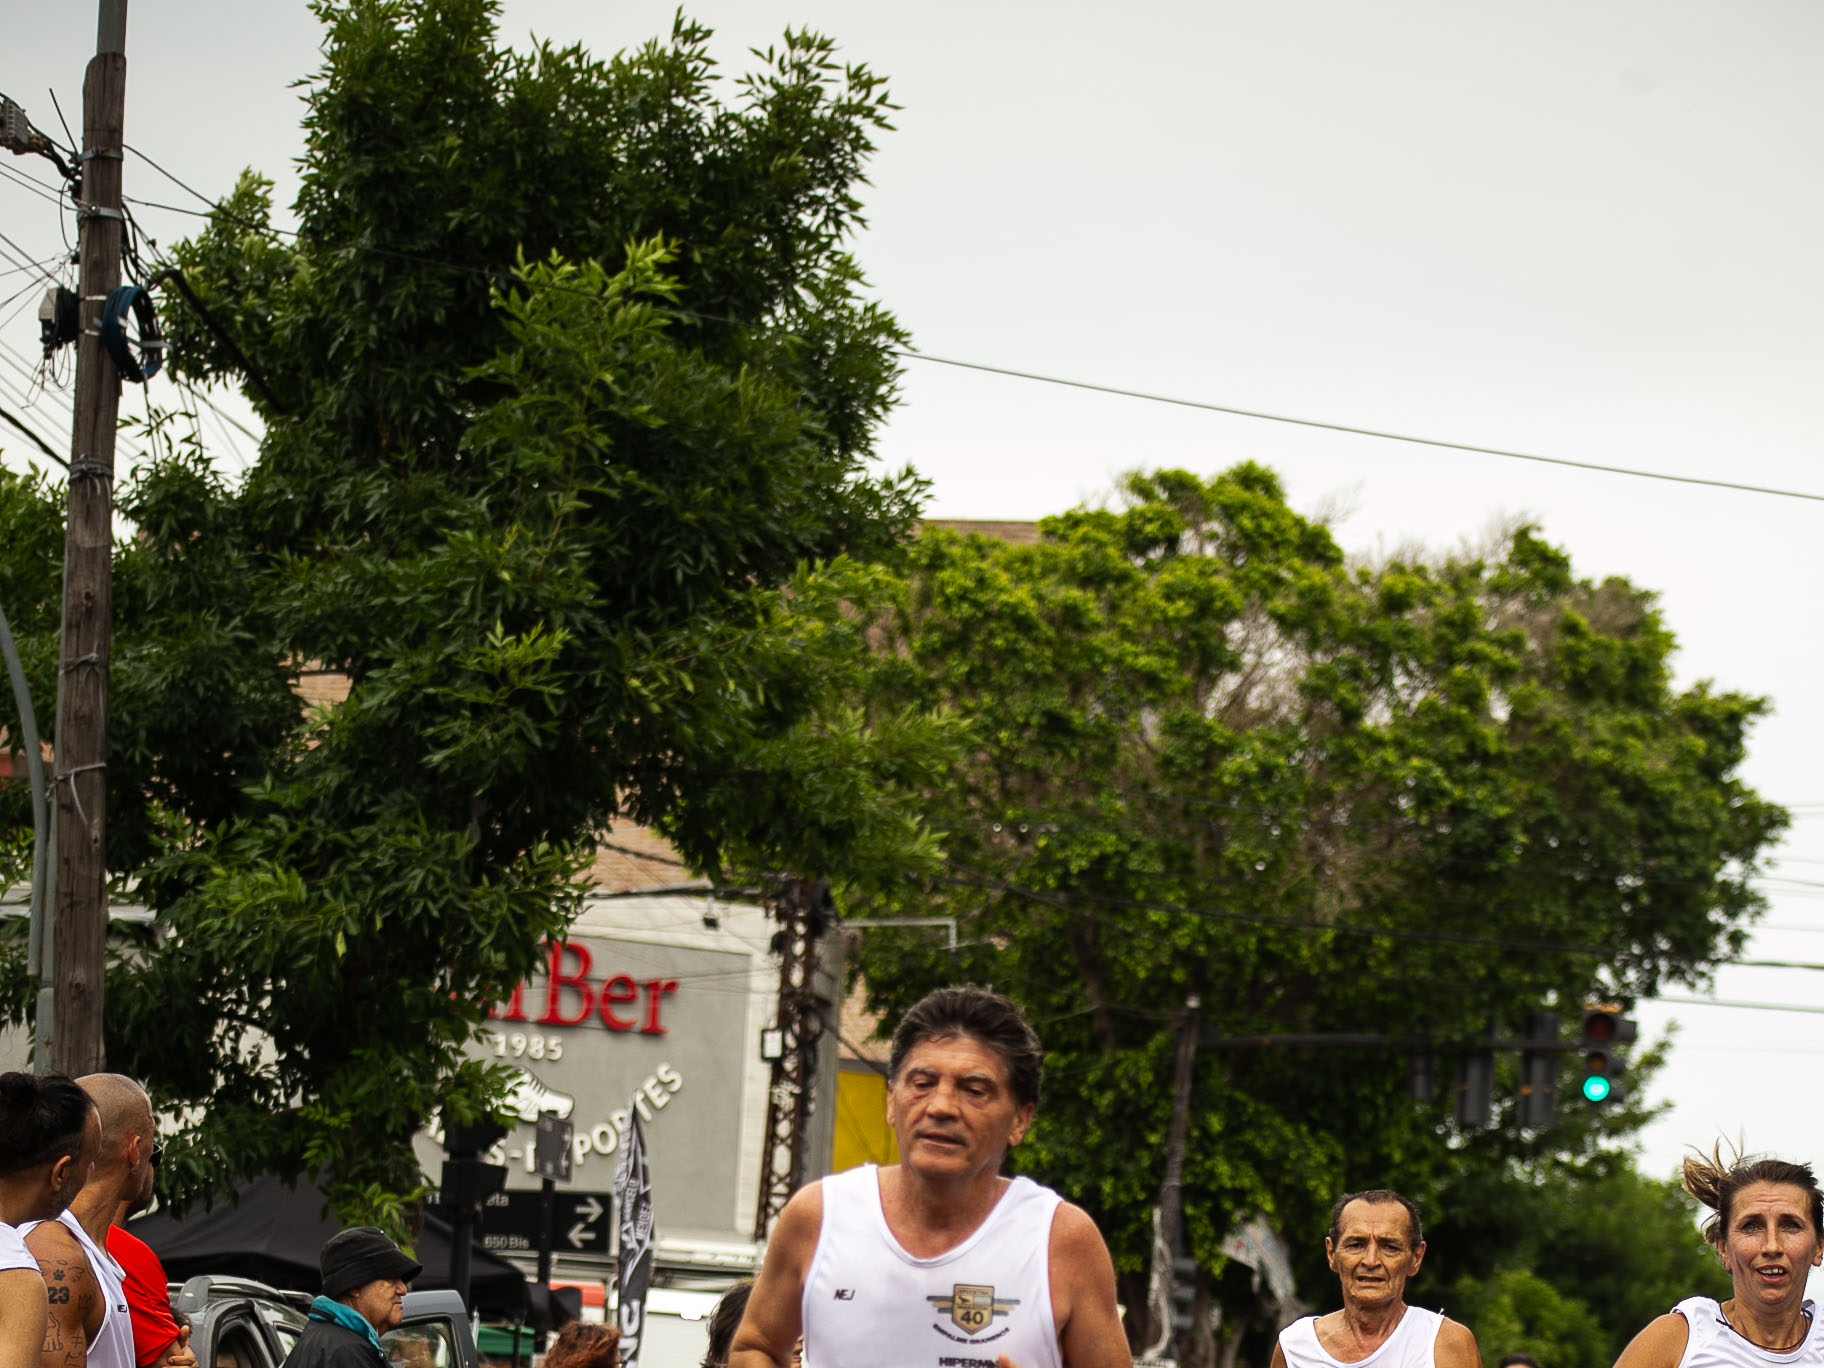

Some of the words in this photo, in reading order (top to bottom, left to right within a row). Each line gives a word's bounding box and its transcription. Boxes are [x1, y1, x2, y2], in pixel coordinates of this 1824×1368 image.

[493, 1032, 564, 1061] 1985
[47, 1286, 70, 1304] 23
[833, 1289, 856, 1301] NEJ
[960, 1310, 984, 1325] 40
